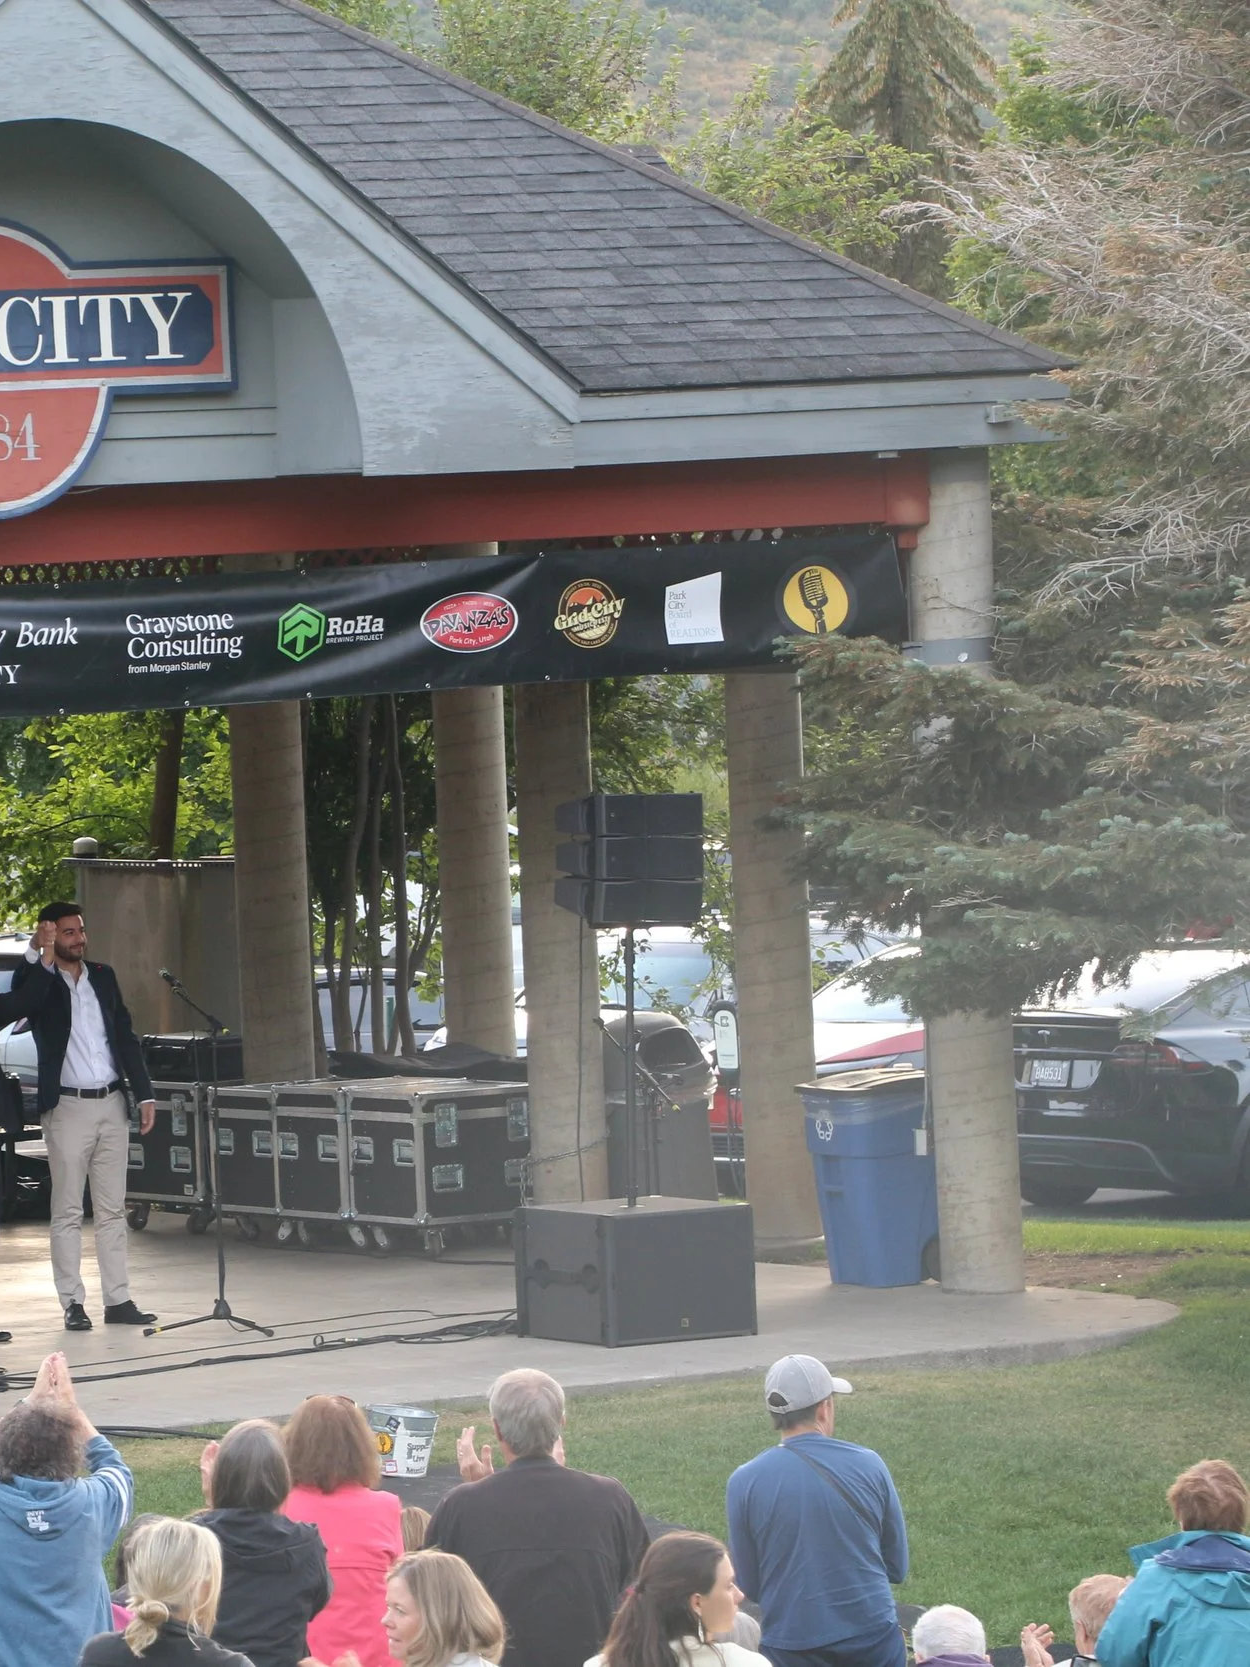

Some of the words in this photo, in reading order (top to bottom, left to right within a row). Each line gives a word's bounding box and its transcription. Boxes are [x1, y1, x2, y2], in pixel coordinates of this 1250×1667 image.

[669, 590, 687, 601] Park
[591, 597, 626, 619] City
[668, 600, 686, 611] City
[16, 617, 79, 648] Bank
[125, 613, 235, 639] Graystone
[326, 615, 385, 636] RoHa
[127, 632, 244, 659] Consulting
[325, 636, 354, 644] BREWING
[355, 633, 384, 642] PROJECT
[449, 635, 463, 644] Park
[478, 634, 494, 643] Utah
[128, 664, 148, 674] from
[149, 663, 181, 674] Morgan
[181, 660, 211, 671] Stanley
